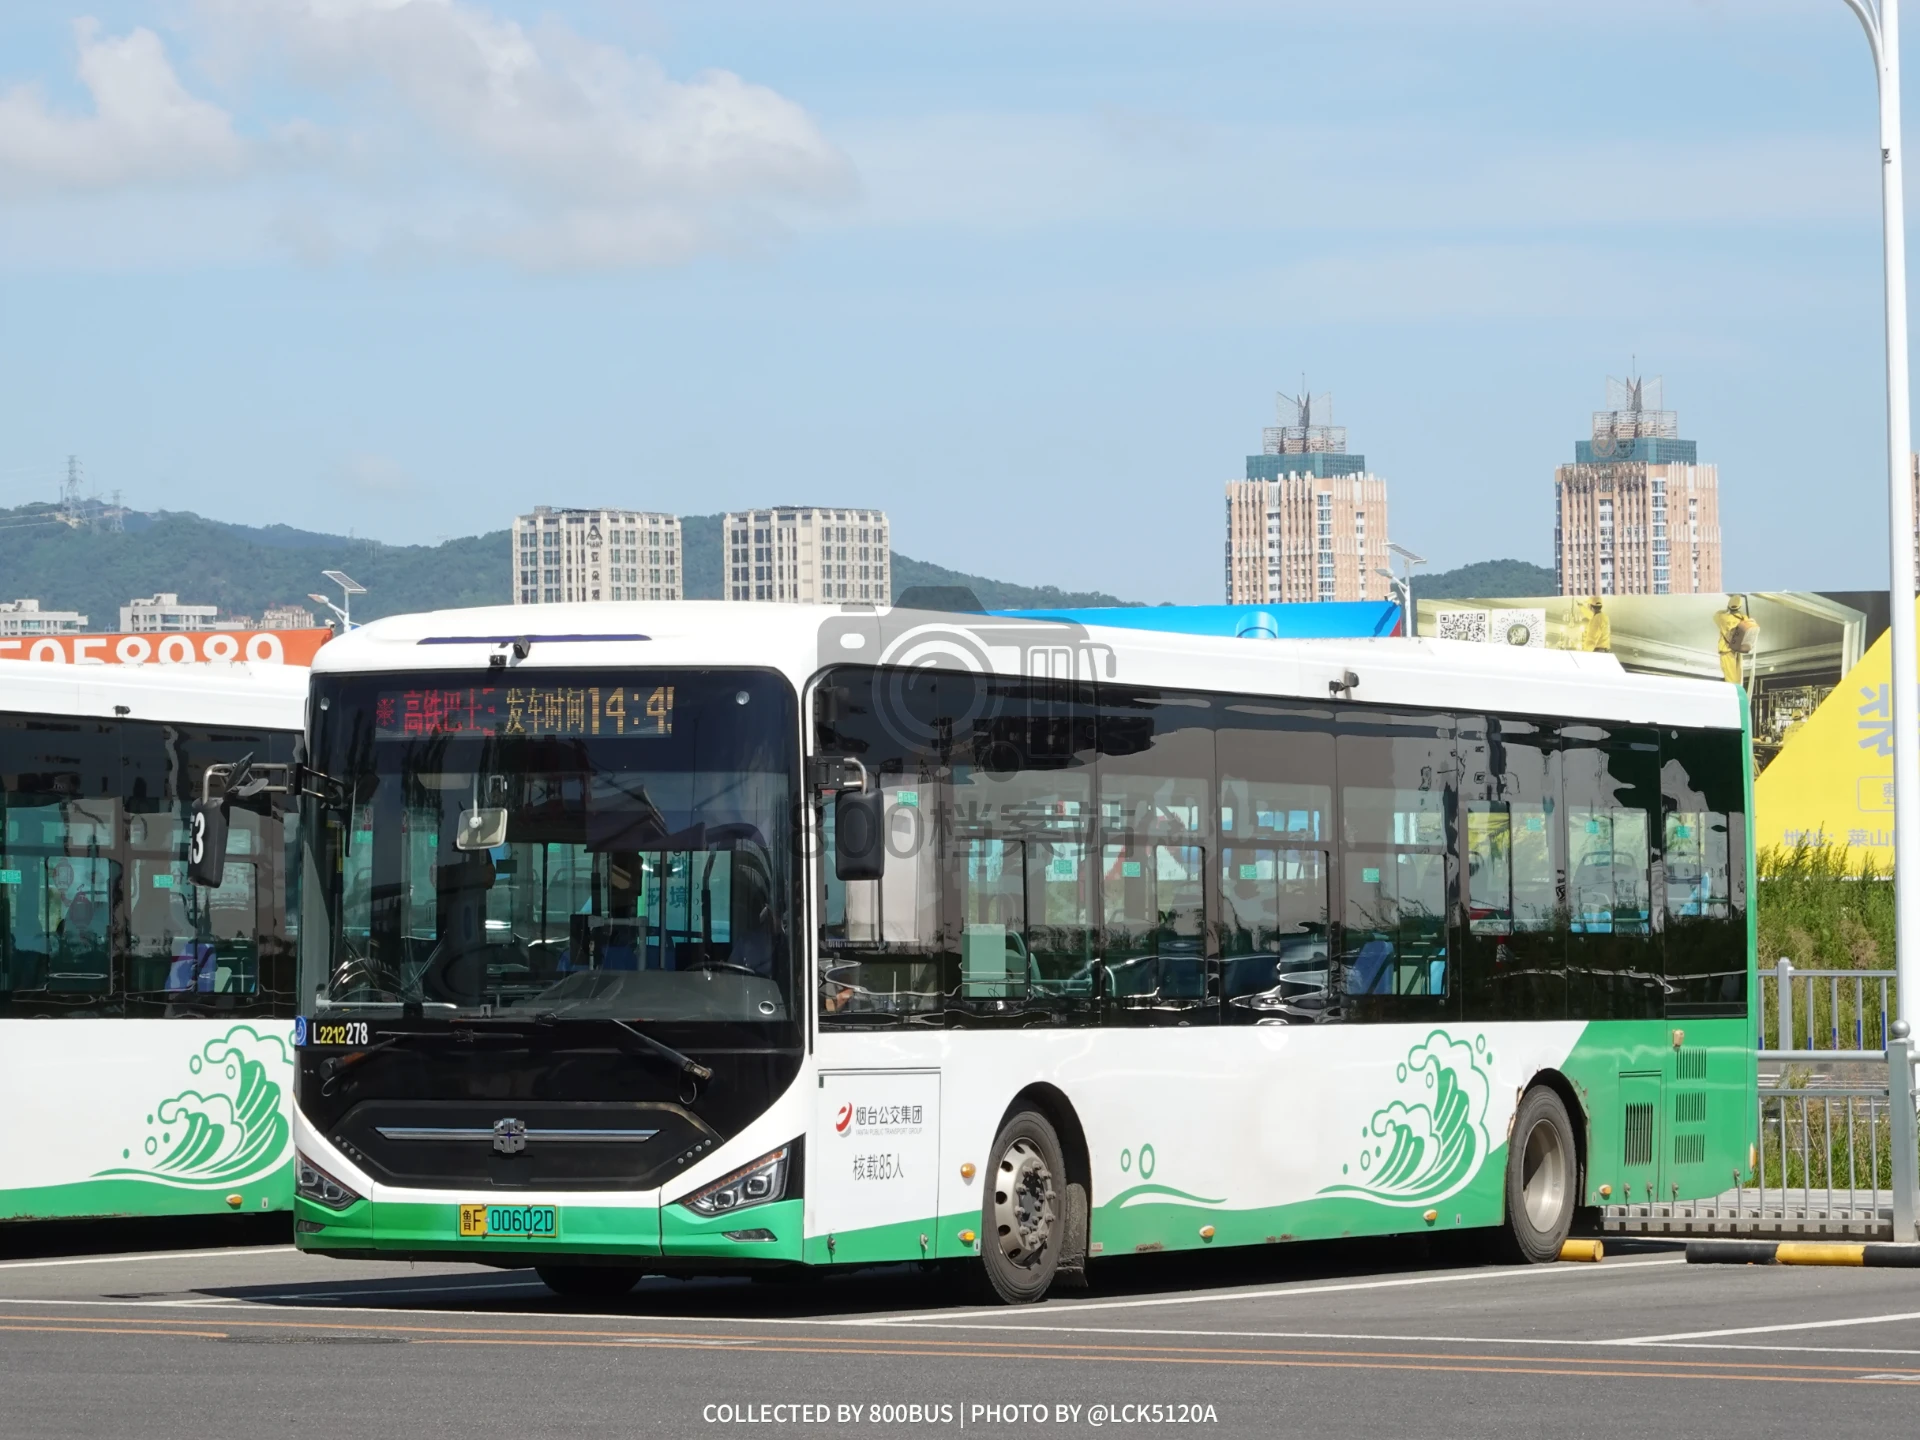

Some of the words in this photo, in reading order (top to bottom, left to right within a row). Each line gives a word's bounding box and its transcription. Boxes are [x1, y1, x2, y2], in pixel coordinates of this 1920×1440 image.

[188, 811, 206, 865] 3
[855, 1105, 922, 1126] 烟台公交集团
[853, 1153, 904, 1181] 核载85人
